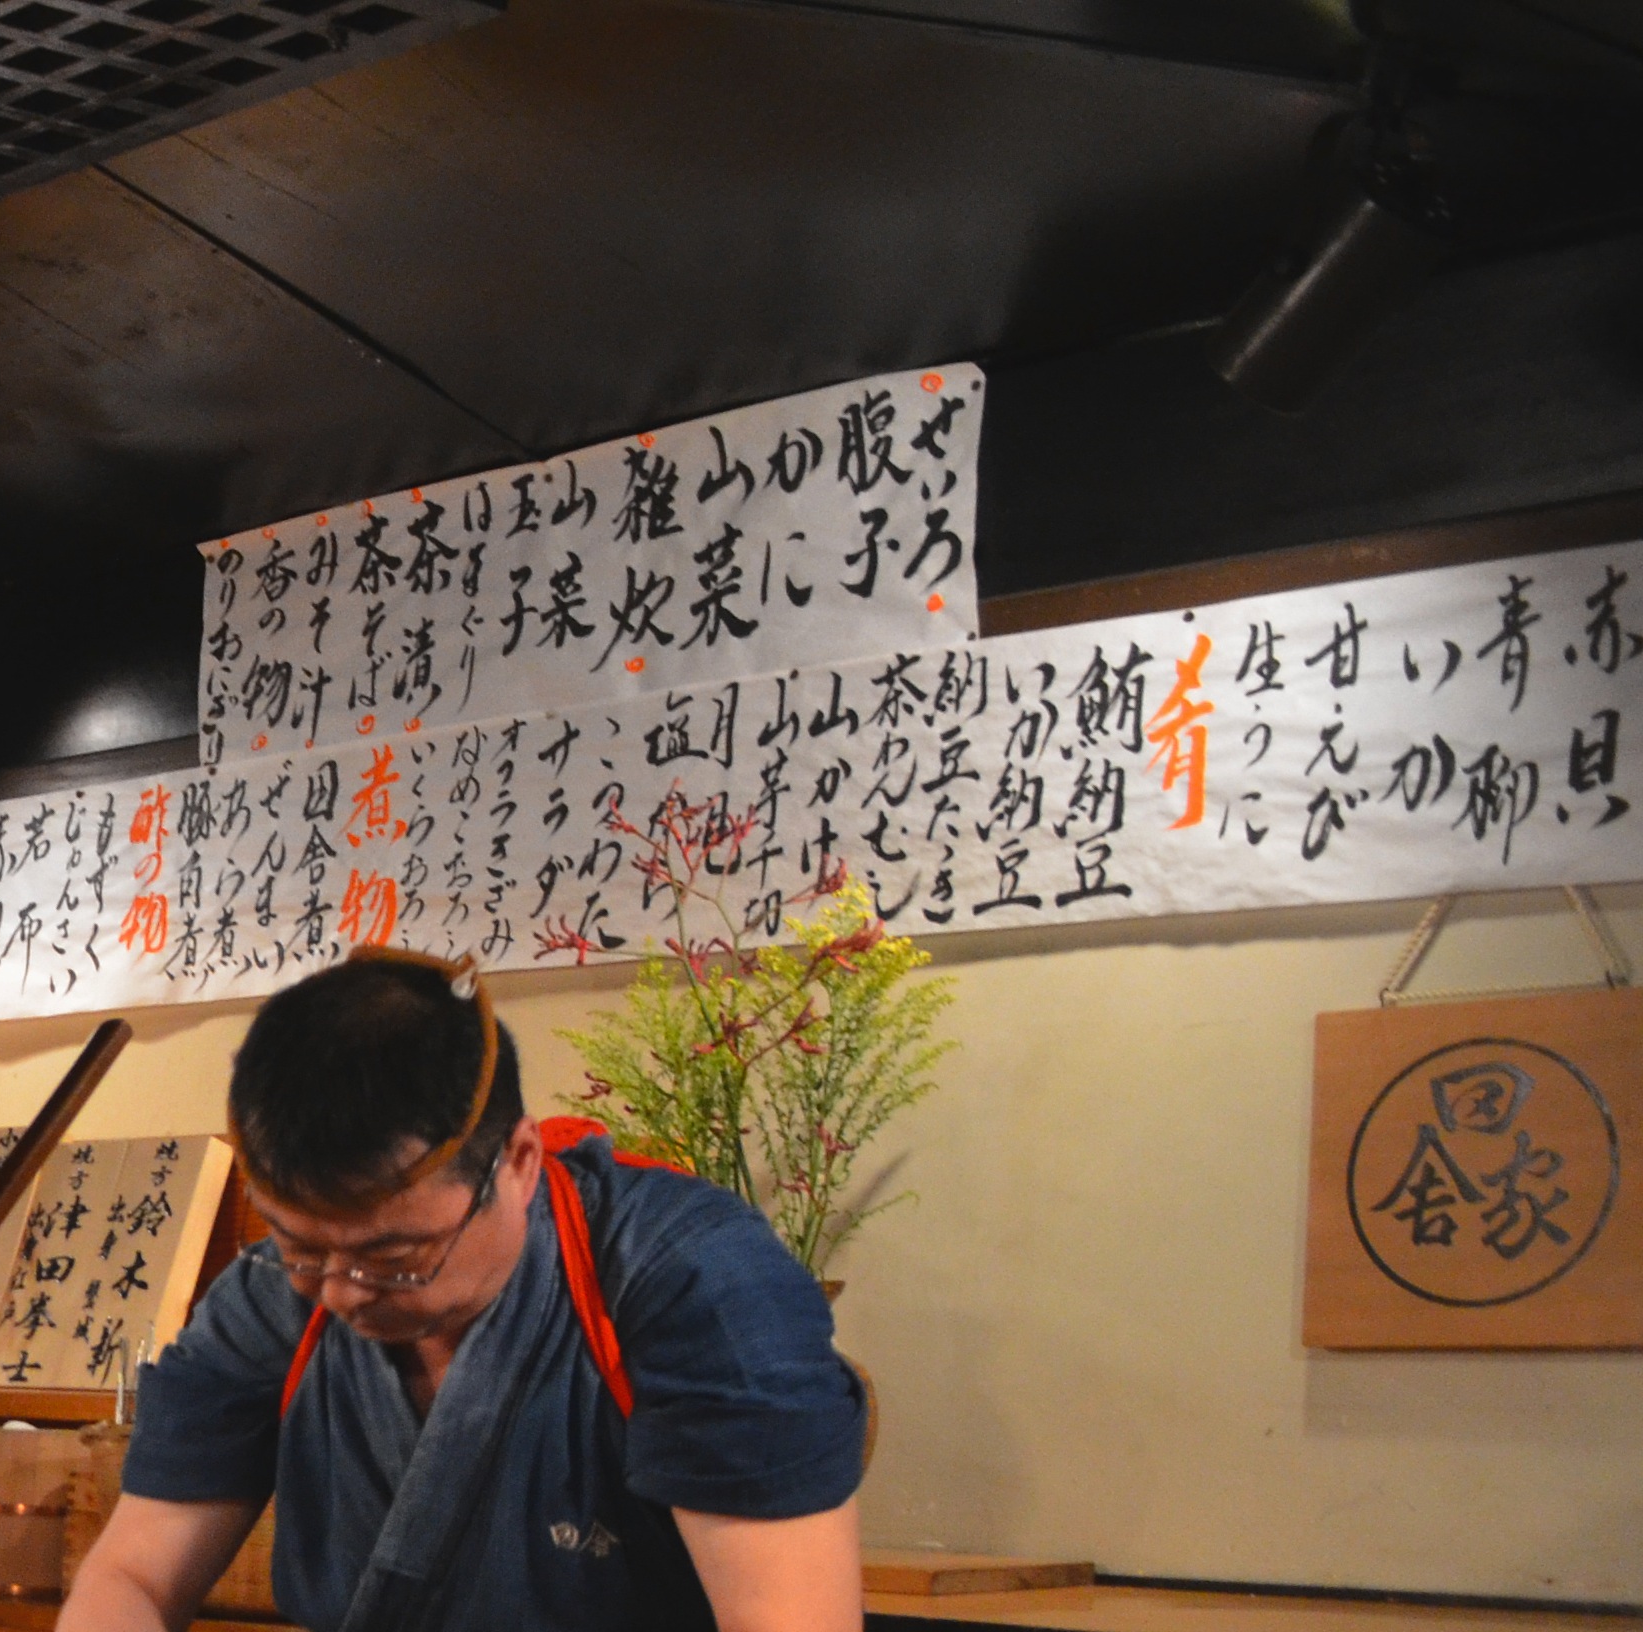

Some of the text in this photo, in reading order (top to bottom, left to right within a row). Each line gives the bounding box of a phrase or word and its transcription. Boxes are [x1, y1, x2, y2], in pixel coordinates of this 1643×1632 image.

[501, 474, 538, 655] 玉子
[537, 459, 597, 648] 山菜
[590, 446, 683, 673] 雑炊
[679, 426, 758, 649] 山菜
[761, 428, 823, 606] かに
[839, 390, 913, 597] 腹子
[904, 397, 964, 592] せいろ
[238, 540, 297, 728] 香の物
[291, 532, 338, 741] みそ汁
[348, 514, 402, 709] 茶そば
[393, 500, 459, 716] 茶漬
[1556, 564, 1643, 827] 赤貝
[530, 720, 580, 918] サラダ
[802, 671, 859, 900] 山かけ
[973, 661, 1058, 915] いか納豆
[1053, 641, 1153, 907] 鮪納豆
[1218, 622, 1286, 846] 生うに
[1302, 602, 1369, 860] 甘えび
[1382, 640, 1462, 811] いか
[1452, 574, 1542, 865] 青柳
[86, 793, 118, 972] もずく
[119, 784, 171, 967] 酢の物
[252, 760, 292, 975] ぜんまい
[285, 760, 339, 961] 田舎煮
[336, 744, 407, 947] 煮物
